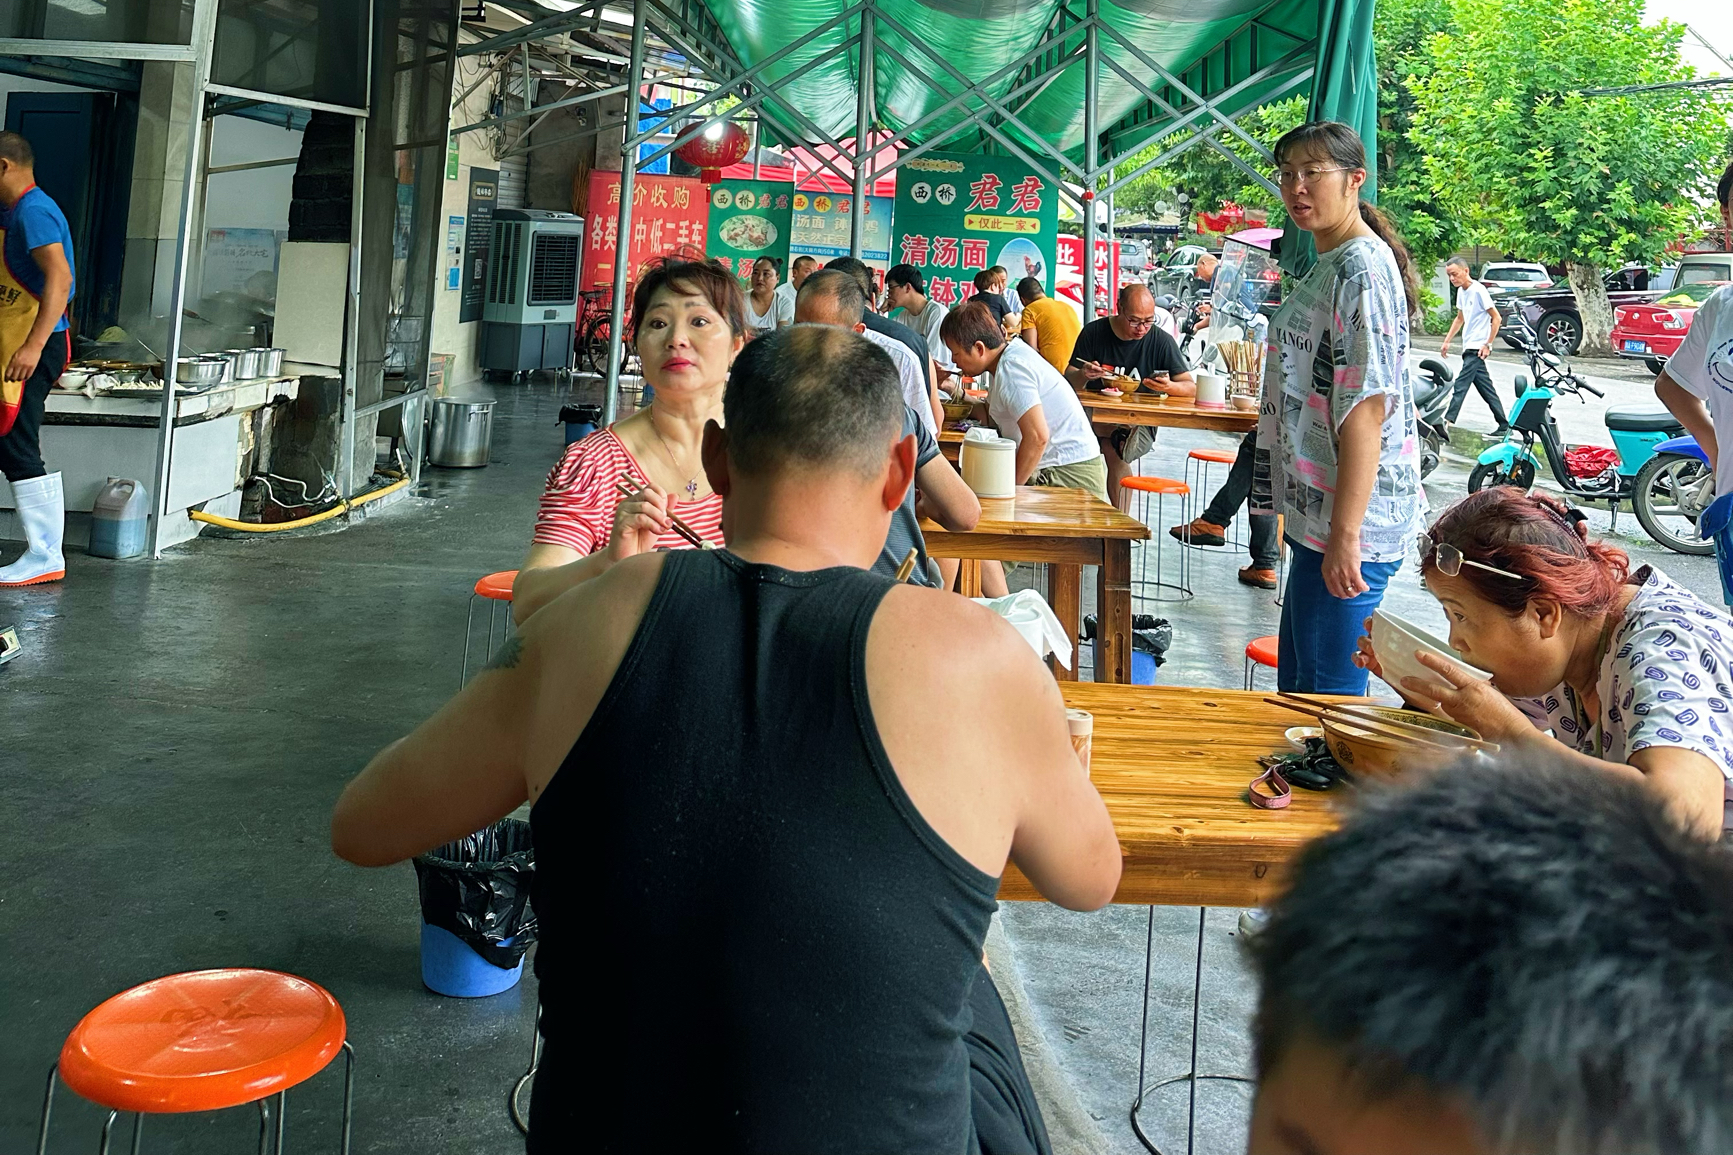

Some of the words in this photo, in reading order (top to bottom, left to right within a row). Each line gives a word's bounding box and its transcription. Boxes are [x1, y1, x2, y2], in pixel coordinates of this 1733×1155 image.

[607, 182, 691, 210] 高价收购
[913, 185, 955, 202] 西桥
[964, 173, 1045, 215] 君君
[591, 214, 704, 256] 各类中低二手车
[834, 217, 879, 234] 钵鸡
[978, 217, 1027, 231] 仅此一家
[900, 233, 989, 270] 清汤面
